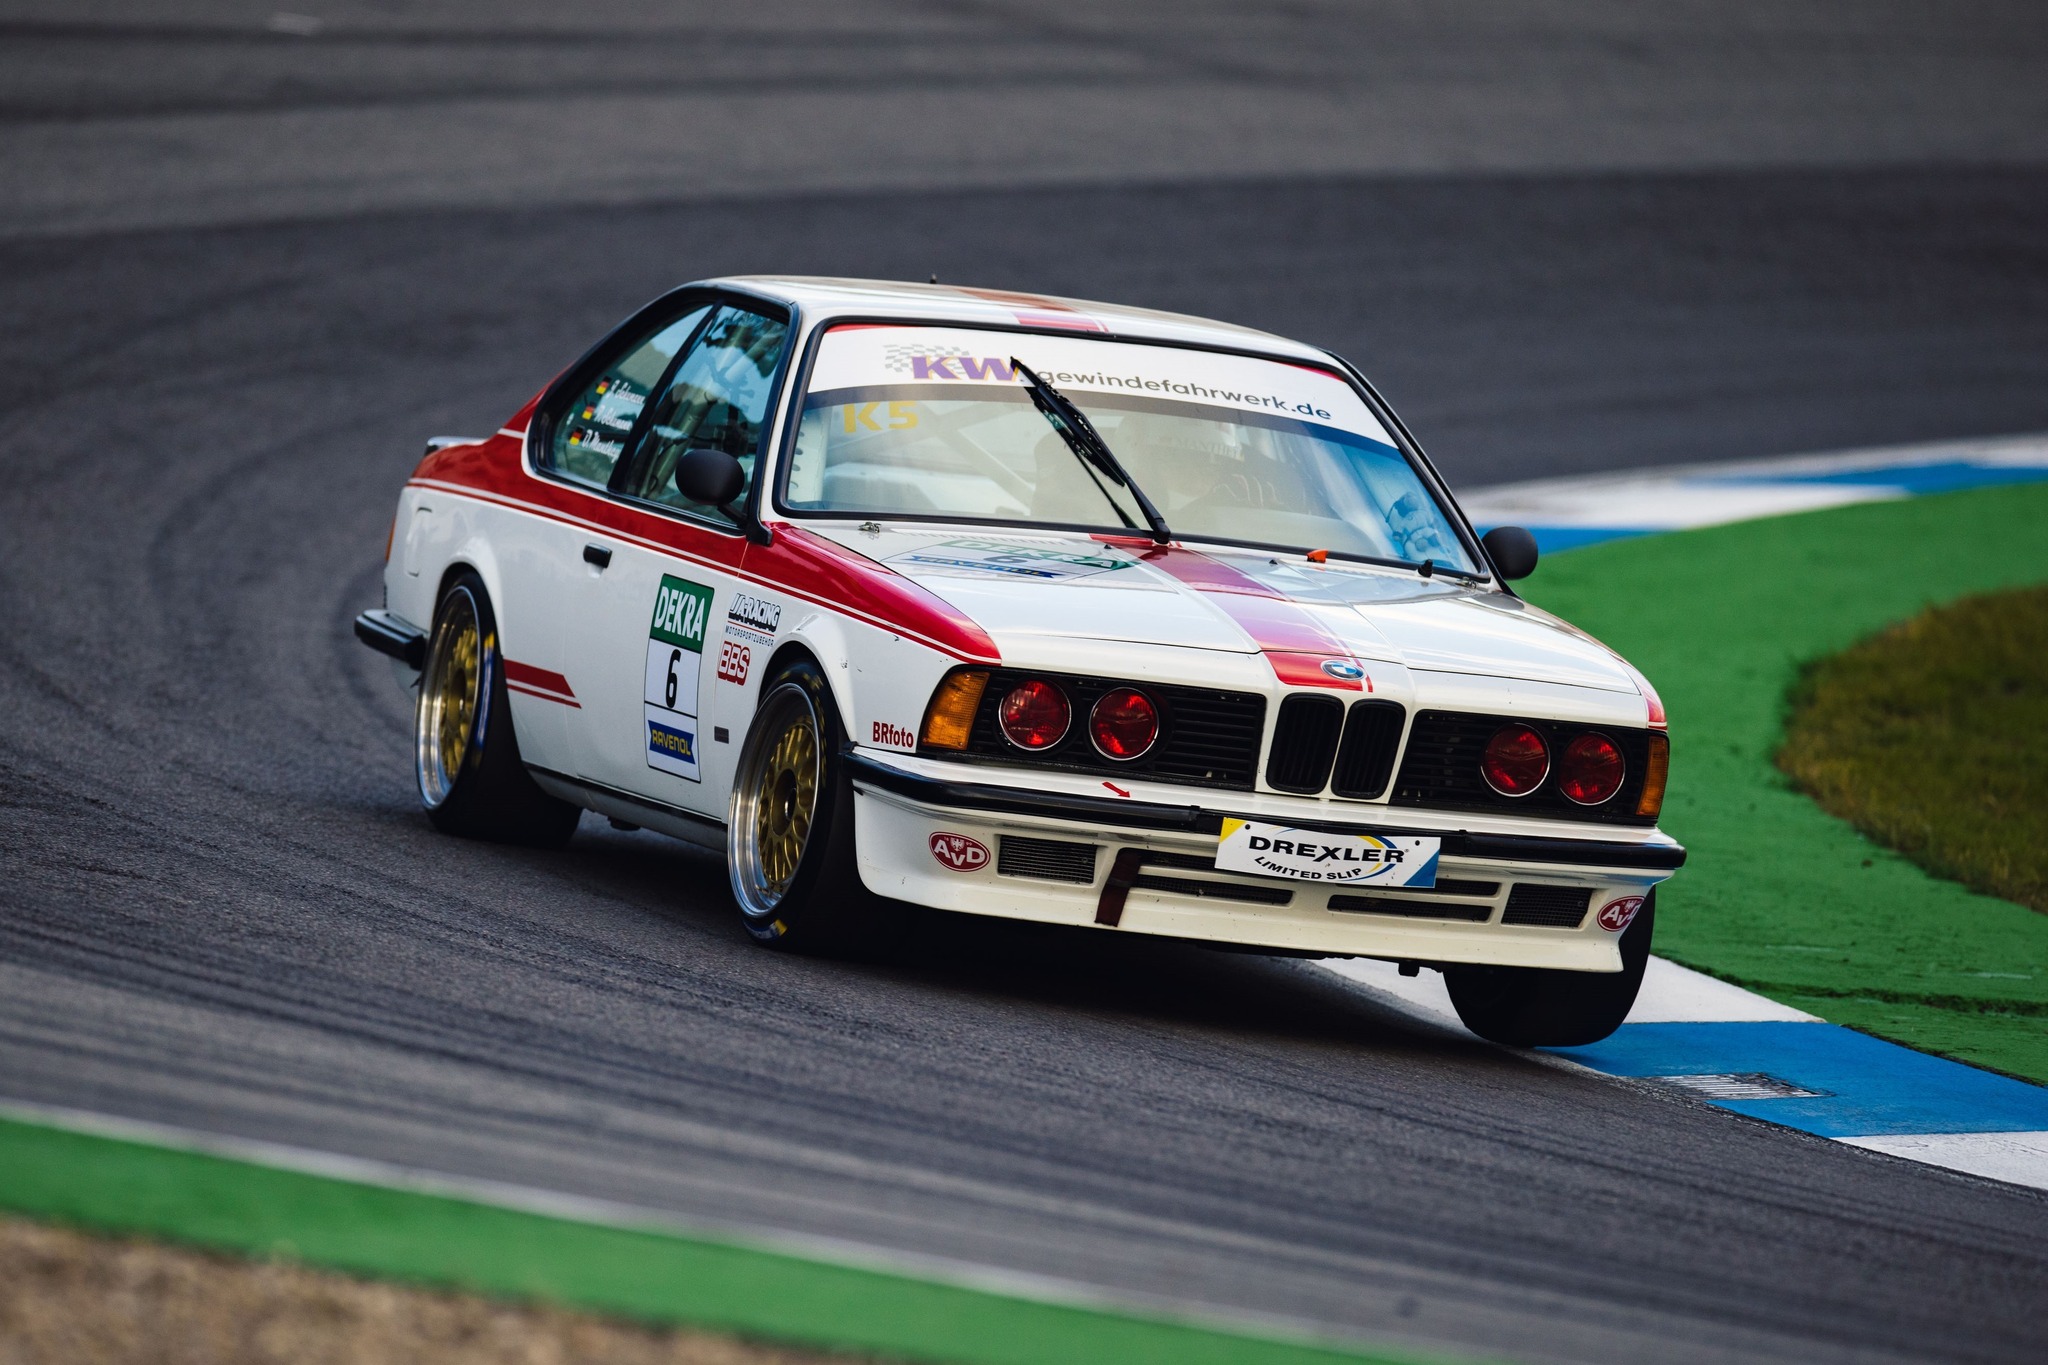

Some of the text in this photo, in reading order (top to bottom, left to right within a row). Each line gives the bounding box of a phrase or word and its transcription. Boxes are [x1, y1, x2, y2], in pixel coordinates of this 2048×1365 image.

[1037, 371, 1332, 420] gewindefahrwerk.de
[843, 401, 919, 434] K5
[957, 540, 1114, 568] DEKRA
[653, 586, 706, 641] DEKRA
[717, 640, 751, 686] BBS
[666, 648, 681, 709] 6
[652, 729, 691, 756] RAVENOL
[872, 721, 914, 748] BRfoto
[1249, 836, 1405, 862] DREXLER
[1254, 856, 1362, 880] LIMITED SLIP
